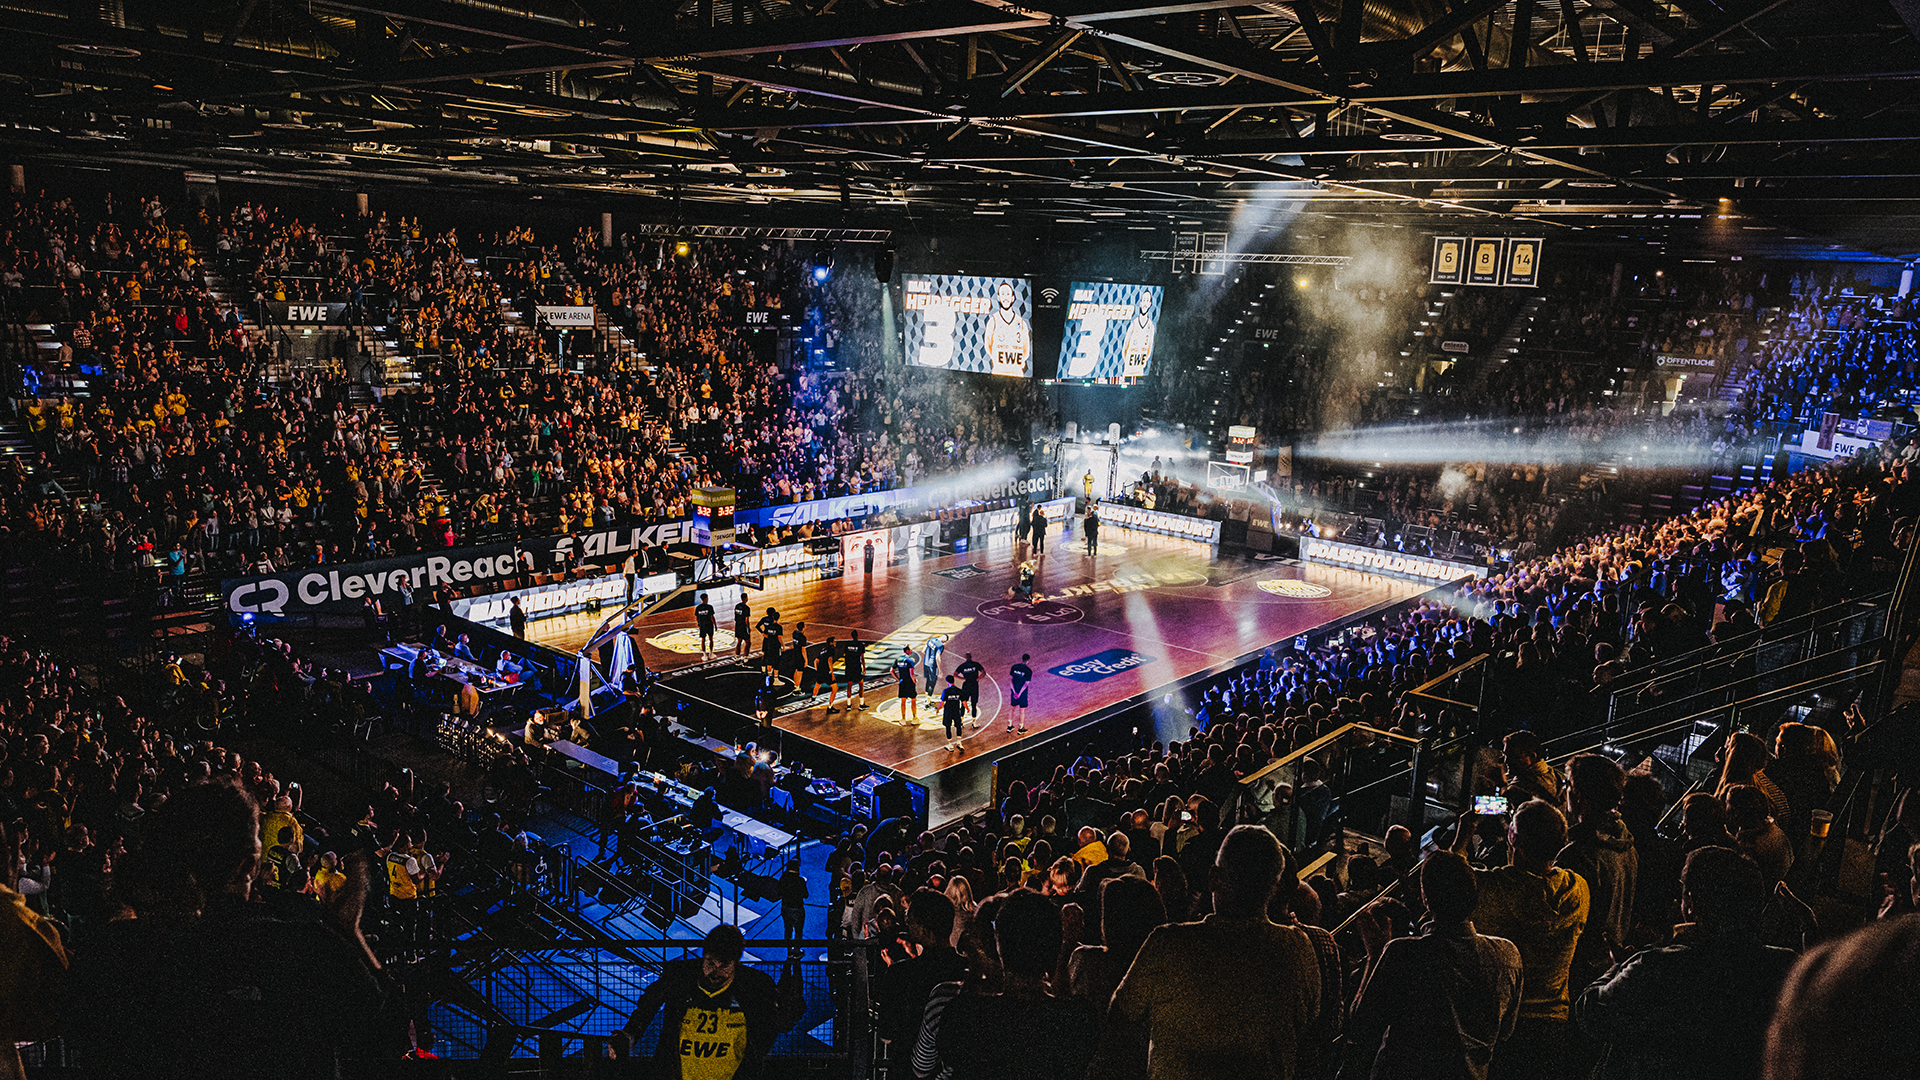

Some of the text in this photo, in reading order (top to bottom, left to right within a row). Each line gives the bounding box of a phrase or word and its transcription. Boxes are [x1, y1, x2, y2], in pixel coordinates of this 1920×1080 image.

[1445, 252, 1453, 263] 6
[1481, 253, 1490, 264] 8
[1516, 254, 1531, 265] 14
[908, 280, 931, 293] MAX
[1073, 289, 1095, 302] MAX
[906, 293, 991, 315] HEIDEGGER
[287, 306, 328, 321] EWE
[550, 312, 592, 320] EWE ARENA
[746, 312, 769, 323] EWE
[1068, 303, 1135, 321] HEIDEGGER
[919, 302, 957, 367] 3
[1255, 329, 1279, 339] EWE
[1068, 312, 1107, 377] 3
[998, 351, 1023, 366] EWE
[1129, 353, 1147, 366] EWE
[1666, 356, 1715, 367] ÖFFENTLICHE
[1834, 443, 1855, 454] EWE
[769, 493, 885, 527] FALKEN
[1252, 518, 1270, 528] EWE
[297, 549, 535, 606] CleverReach
[520, 579, 627, 614] HEIDEGGER
[1093, 655, 1148, 674] Credit
[392, 865, 397, 879] 4
[696, 1012, 719, 1035] 23
[680, 1038, 731, 1058] EWE
